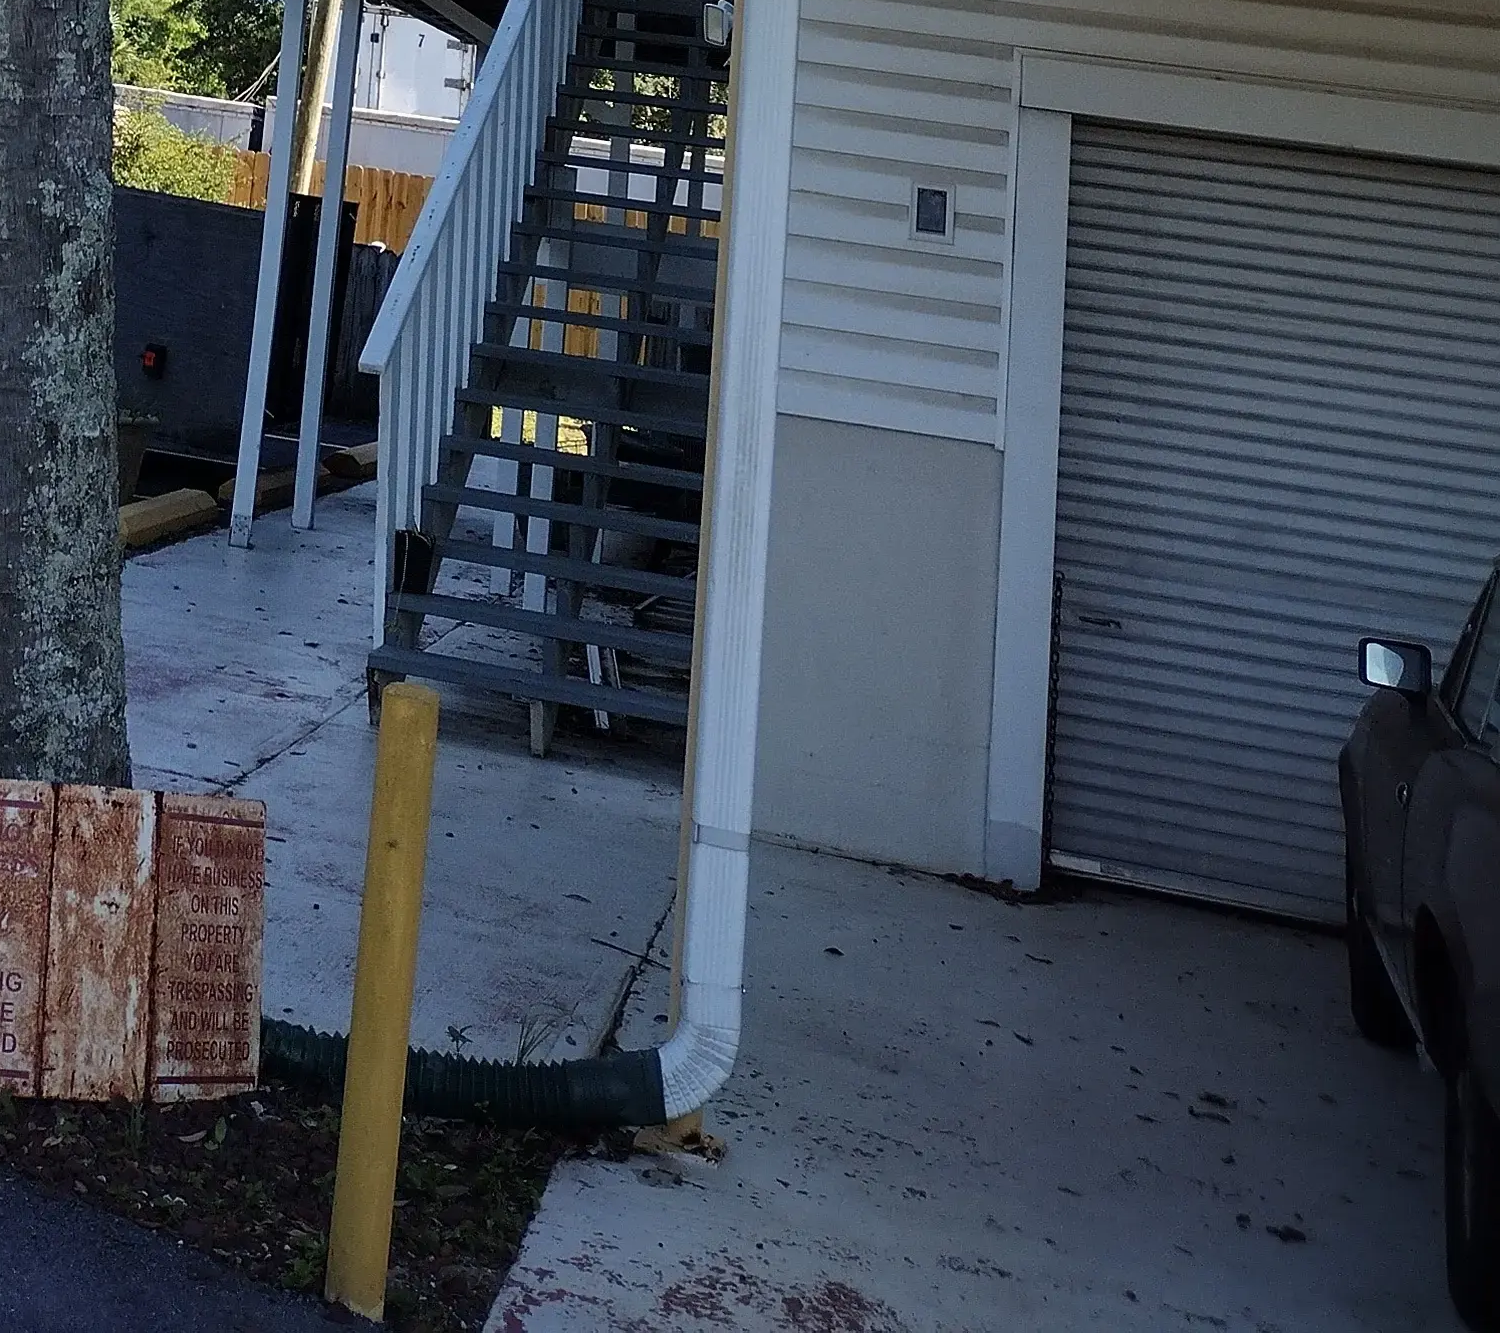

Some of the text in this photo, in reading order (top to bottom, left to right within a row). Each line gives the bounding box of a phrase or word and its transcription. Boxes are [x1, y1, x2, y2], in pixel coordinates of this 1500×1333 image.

[418, 33, 426, 49] 7
[187, 836, 211, 857] YOU
[204, 866, 262, 889] BUSINESS
[191, 894, 239, 916] ON THIS
[181, 923, 246, 945] PROPERTY
[186, 952, 240, 973] YOU ARE
[169, 981, 254, 1002] TRESPASSING
[170, 1012, 250, 1031] AND WILL BE
[166, 1040, 250, 1061] PROSECUTED
